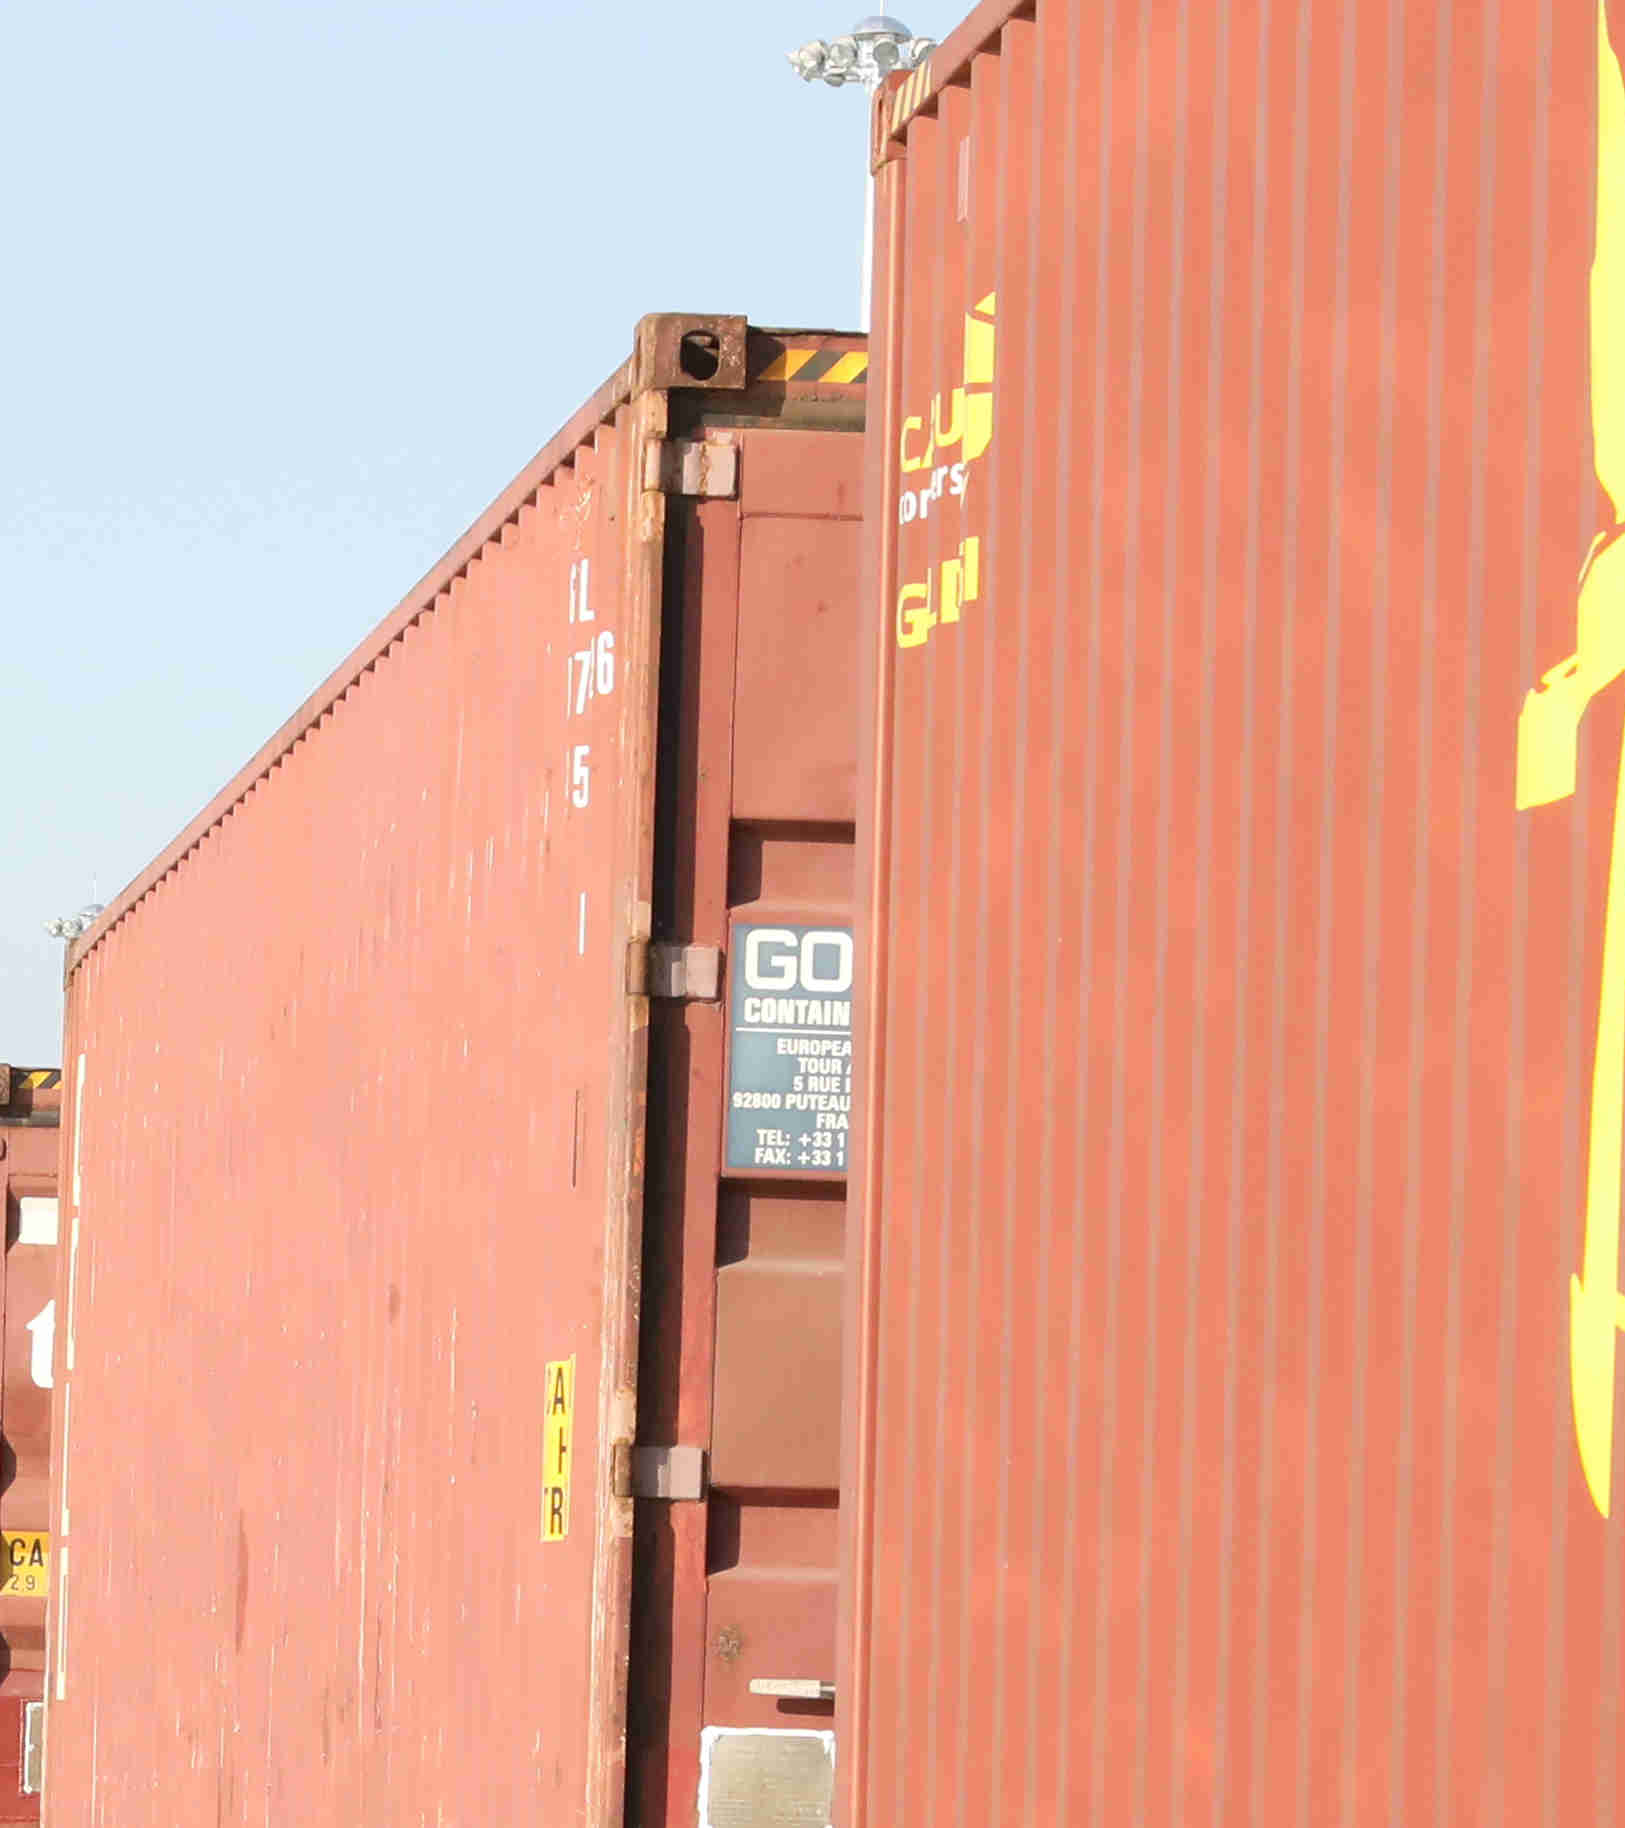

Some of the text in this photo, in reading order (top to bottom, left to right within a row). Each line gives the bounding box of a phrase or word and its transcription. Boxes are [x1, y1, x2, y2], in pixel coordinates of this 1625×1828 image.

[744, 929, 853, 993] GO
[744, 997, 851, 1026] CONTAIN
[776, 1037, 851, 1057] EUROPEA
[798, 1056, 843, 1075] TOUR
[793, 1075, 804, 1092] 5
[808, 1076, 841, 1093] RUE
[733, 1092, 851, 1112] 92800 PUTEAU
[816, 1112, 848, 1130] FRA
[756, 1129, 845, 1149] TEL: +33 1
[754, 1147, 844, 1168] FAX: +33 1
[10, 1537, 43, 1567] CA
